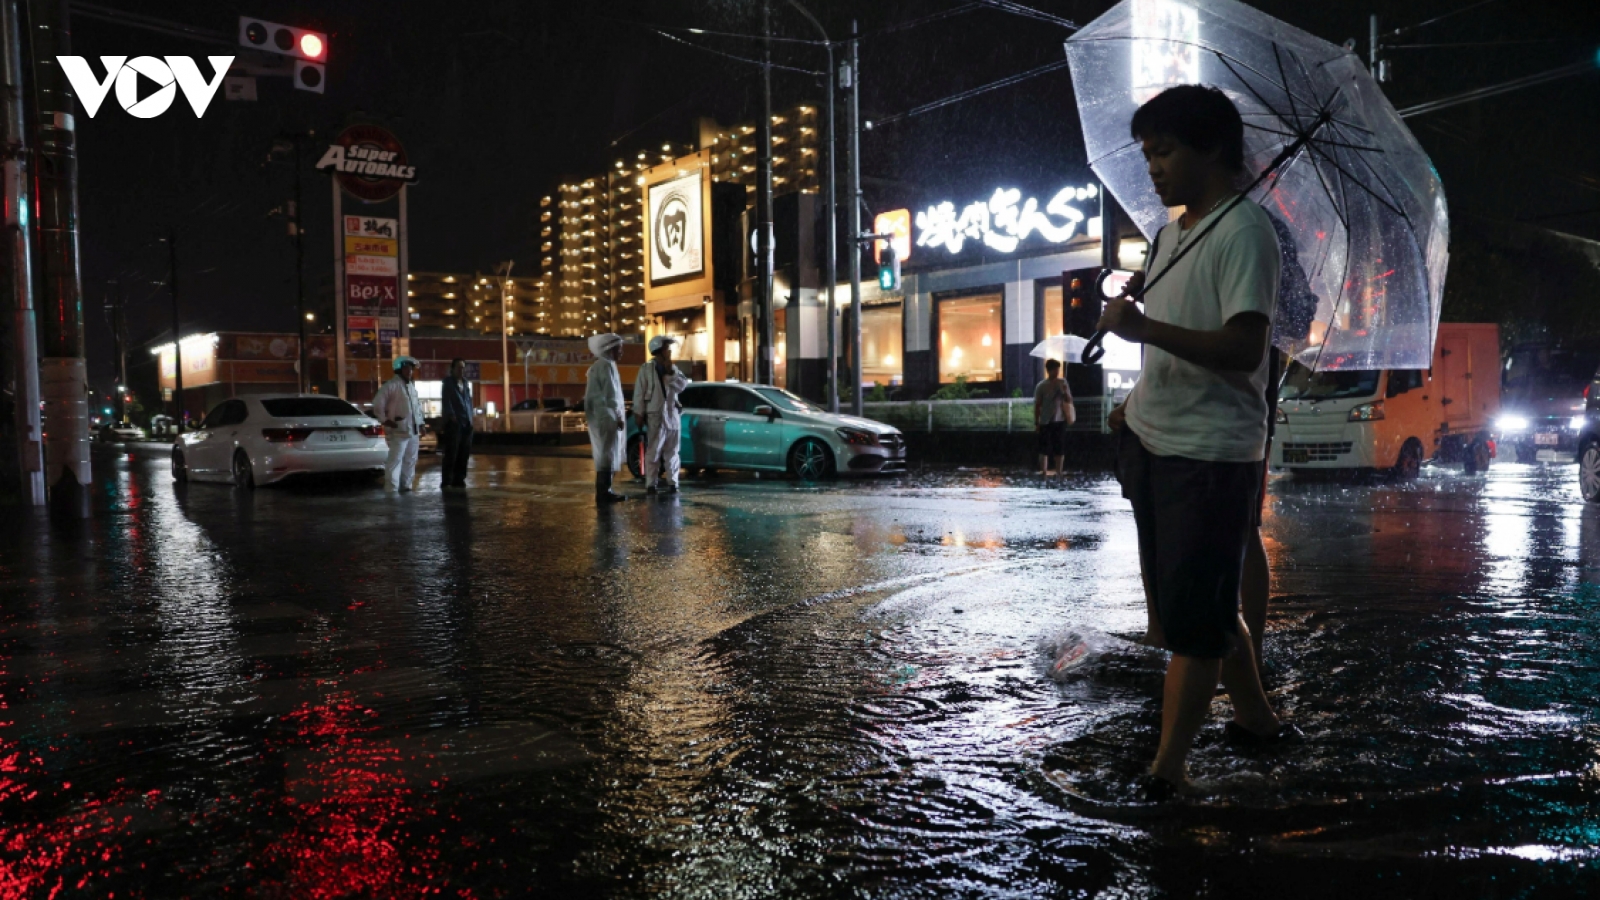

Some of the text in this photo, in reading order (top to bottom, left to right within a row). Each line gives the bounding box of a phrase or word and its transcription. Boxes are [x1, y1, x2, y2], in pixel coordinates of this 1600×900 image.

[315, 144, 417, 179] AUTOBACS
[347, 144, 398, 162] Super
[915, 183, 1098, 254] 焼肉きんぐ
